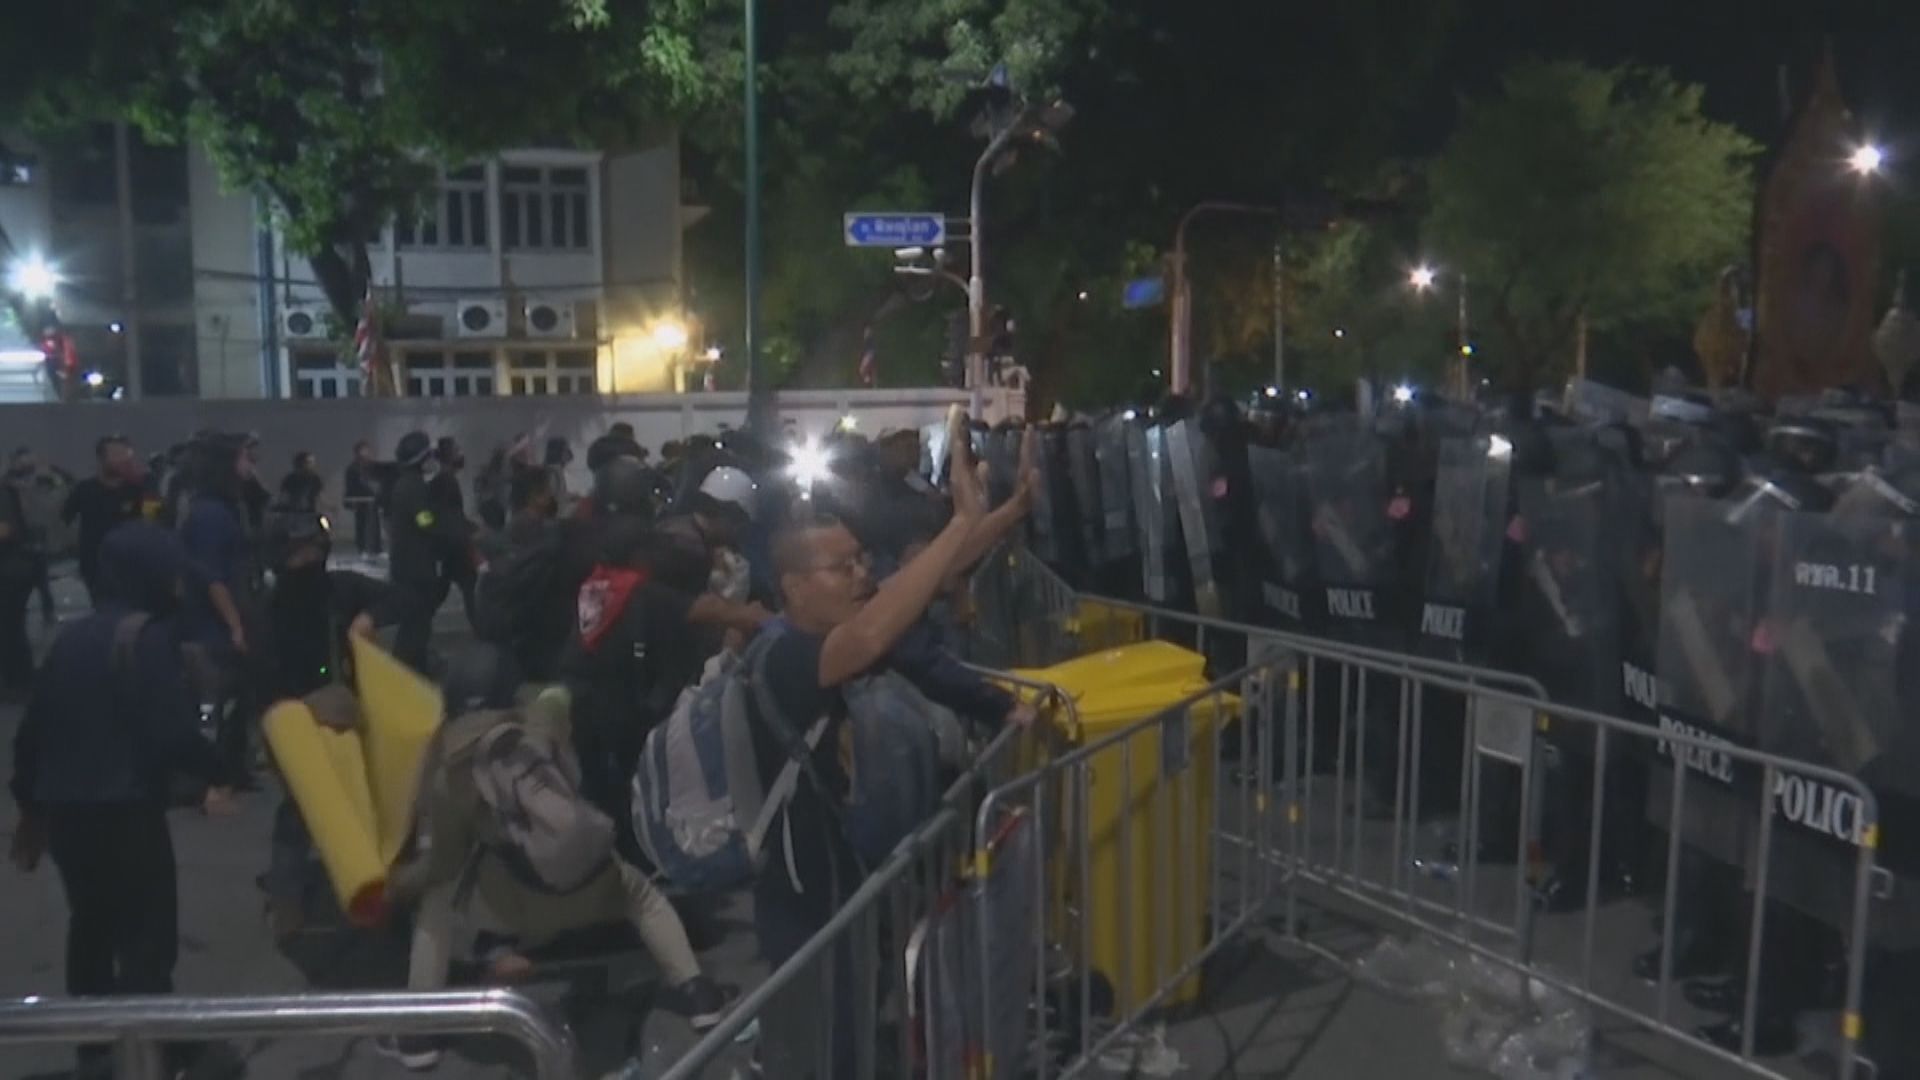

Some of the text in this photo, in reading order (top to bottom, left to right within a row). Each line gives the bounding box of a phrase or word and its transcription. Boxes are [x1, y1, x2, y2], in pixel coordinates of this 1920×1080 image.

[1263, 581, 1302, 621] POLICE
[1326, 586, 1375, 620] POLICE
[1421, 602, 1467, 640] POLICE
[1623, 661, 1664, 709] POLI
